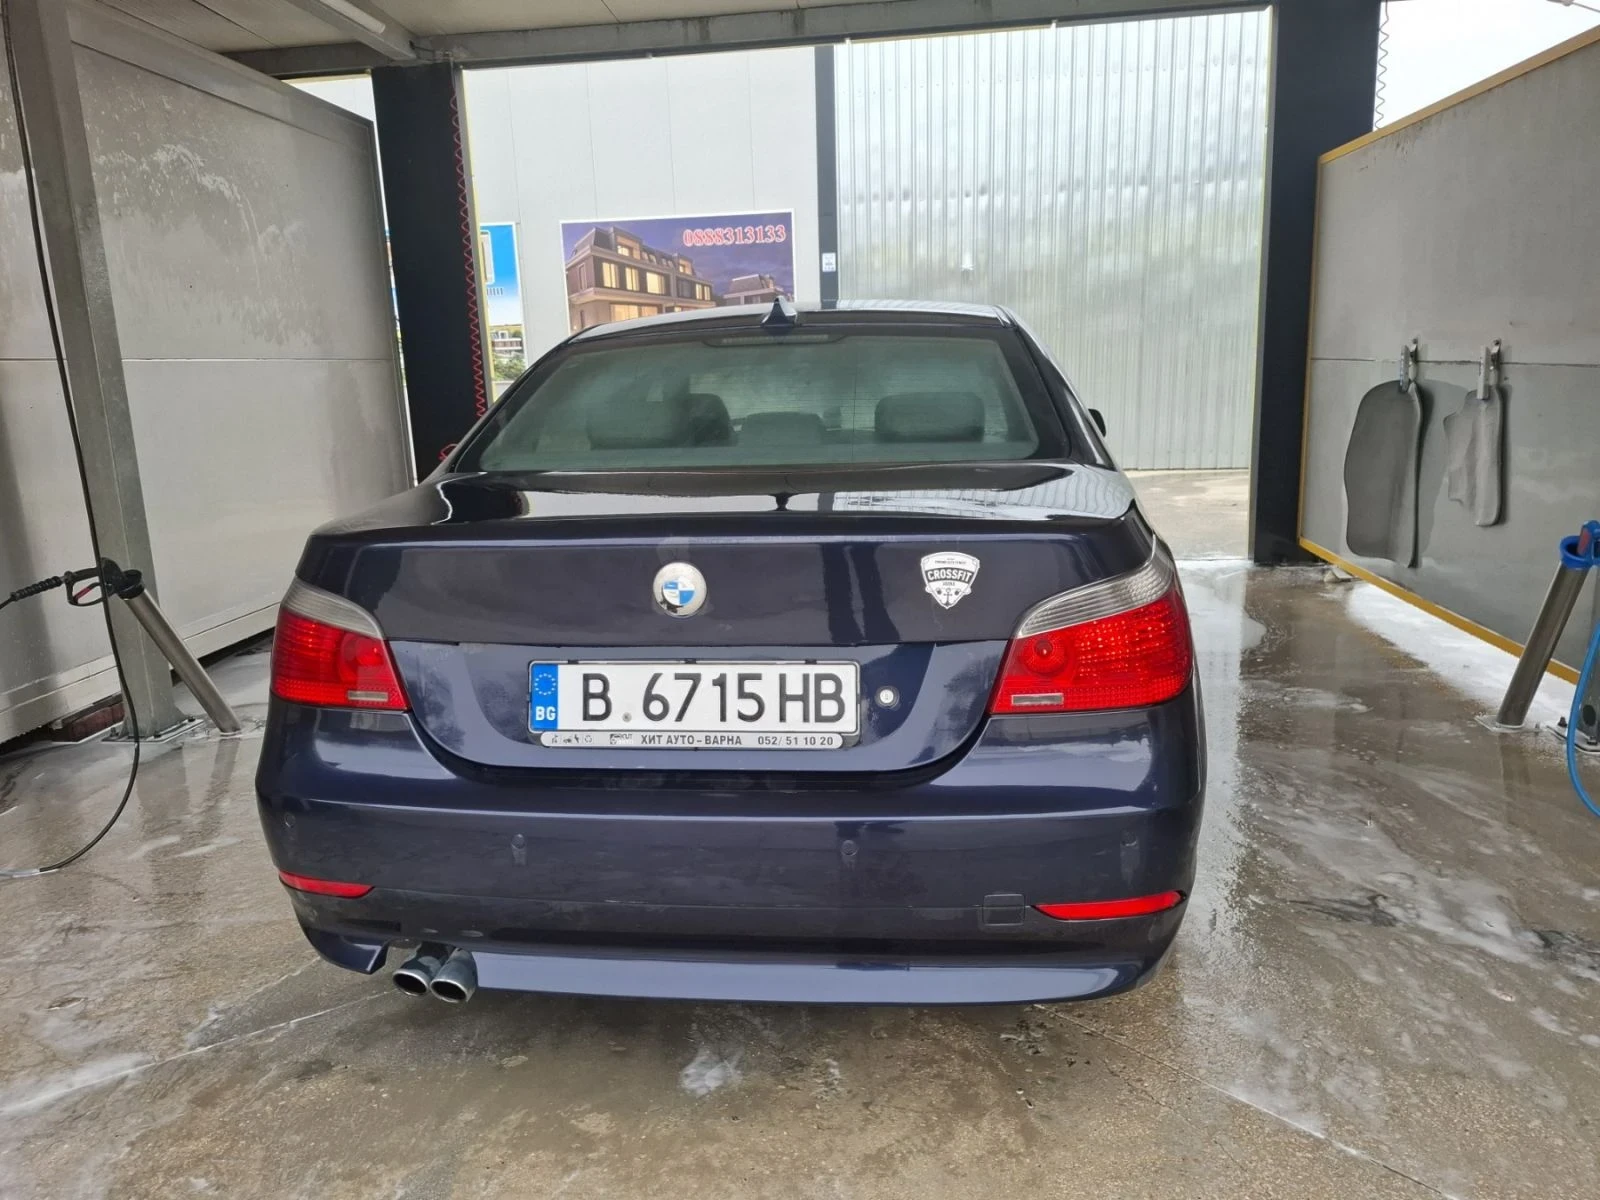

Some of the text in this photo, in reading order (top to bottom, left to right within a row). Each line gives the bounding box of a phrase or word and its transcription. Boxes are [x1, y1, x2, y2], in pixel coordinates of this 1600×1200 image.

[683, 224, 786, 247] 0888313133
[927, 568, 972, 582] CROSSFIT
[535, 706, 557, 721] BG
[641, 734, 663, 745] ХИТ
[786, 735, 799, 746] 51
[803, 735, 816, 746] 10
[819, 735, 834, 746] 20
